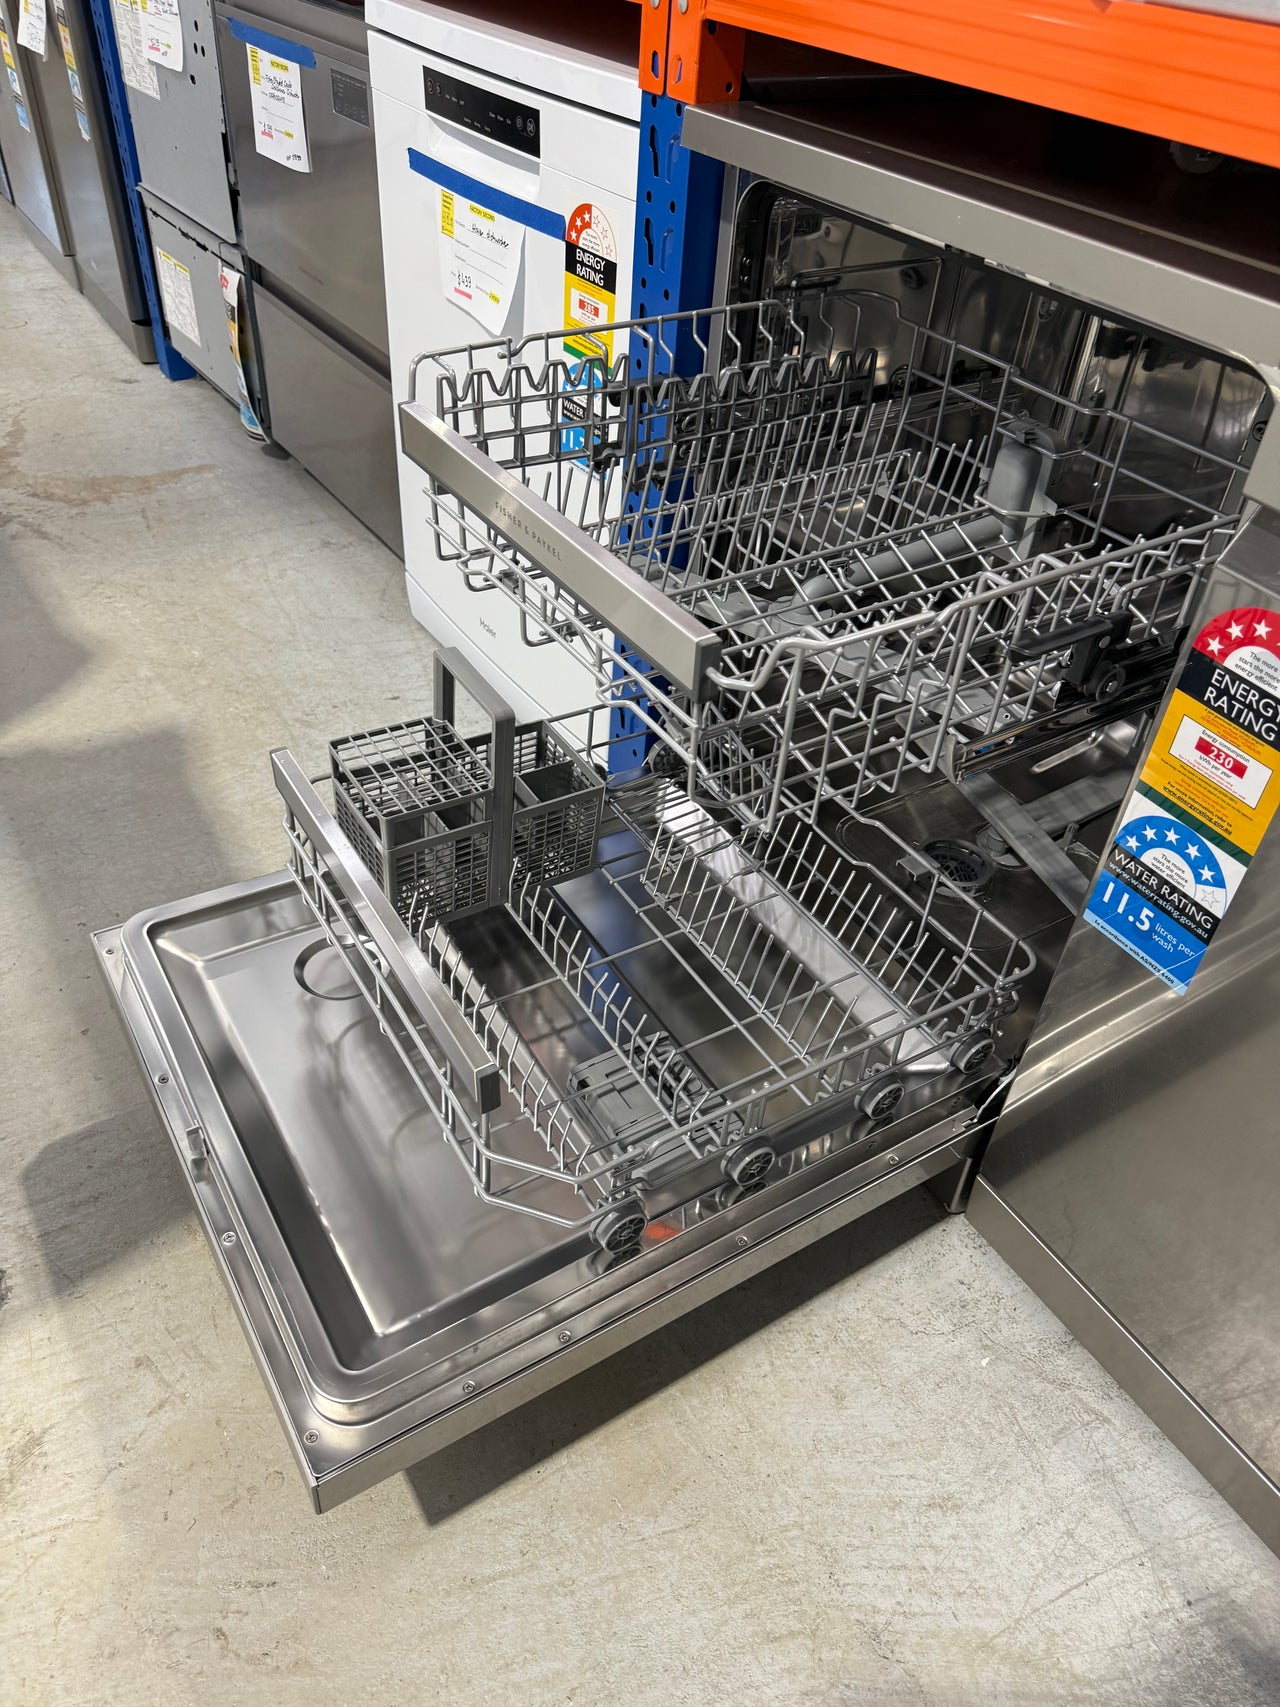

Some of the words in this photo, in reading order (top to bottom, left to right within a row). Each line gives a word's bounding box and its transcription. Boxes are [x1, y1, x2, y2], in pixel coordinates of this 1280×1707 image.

[576, 248, 605, 271] ENERGY
[576, 263, 604, 286] RATING
[584, 302, 595, 315] 285
[563, 398, 584, 418] WATER
[495, 501, 522, 530] FISHER
[524, 525, 529, 534] &
[532, 531, 562, 561] PAYKEL
[480, 617, 496, 639] Haier
[1239, 656, 1252, 667] stars
[1253, 664, 1264, 674] the
[1250, 652, 1261, 661] The
[1261, 659, 1278, 672] more
[1235, 663, 1253, 678] energy
[1255, 674, 1278, 691] efficient
[1204, 687, 1278, 740] RATING
[1201, 729, 1217, 742] Energy
[1219, 741, 1250, 764] consumption
[1208, 746, 1233, 769] 230
[1213, 763, 1223, 774] per
[1221, 768, 1232, 779] year
[1151, 862, 1166, 875] water
[1166, 872, 1185, 889] efficient
[1153, 856, 1165, 868] stars
[1165, 864, 1174, 874] the
[1175, 871, 1188, 883] more
[1161, 854, 1170, 863] The
[1172, 862, 1185, 874] more
[1109, 862, 1208, 939] www.waterrating.gov.au
[1114, 849, 1158, 891] WATER
[1161, 886, 1213, 929] RATING
[1103, 881, 1155, 932] 11.5
[1152, 933, 1173, 953] wash
[1155, 922, 1177, 944] litres
[1178, 942, 1195, 958] per
